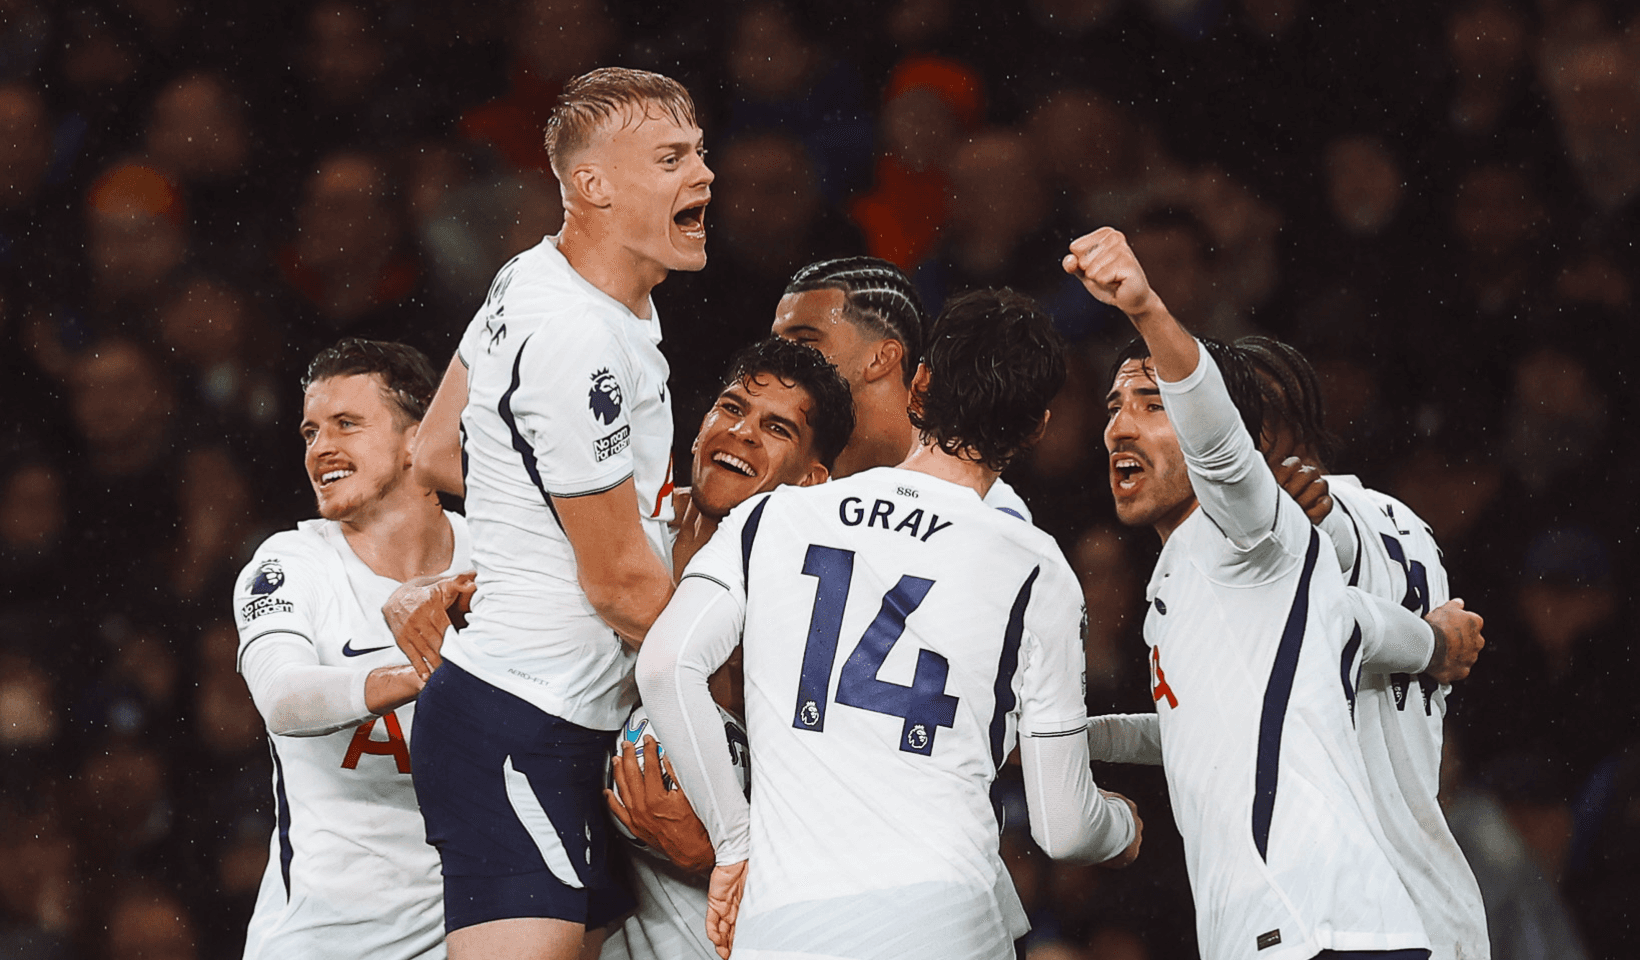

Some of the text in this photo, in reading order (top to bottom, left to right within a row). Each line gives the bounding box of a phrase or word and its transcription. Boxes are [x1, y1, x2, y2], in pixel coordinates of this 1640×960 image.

[610, 427, 628, 446] room
[896, 486, 919, 499] 886
[839, 496, 953, 542] GRAY
[792, 543, 960, 757] 14
